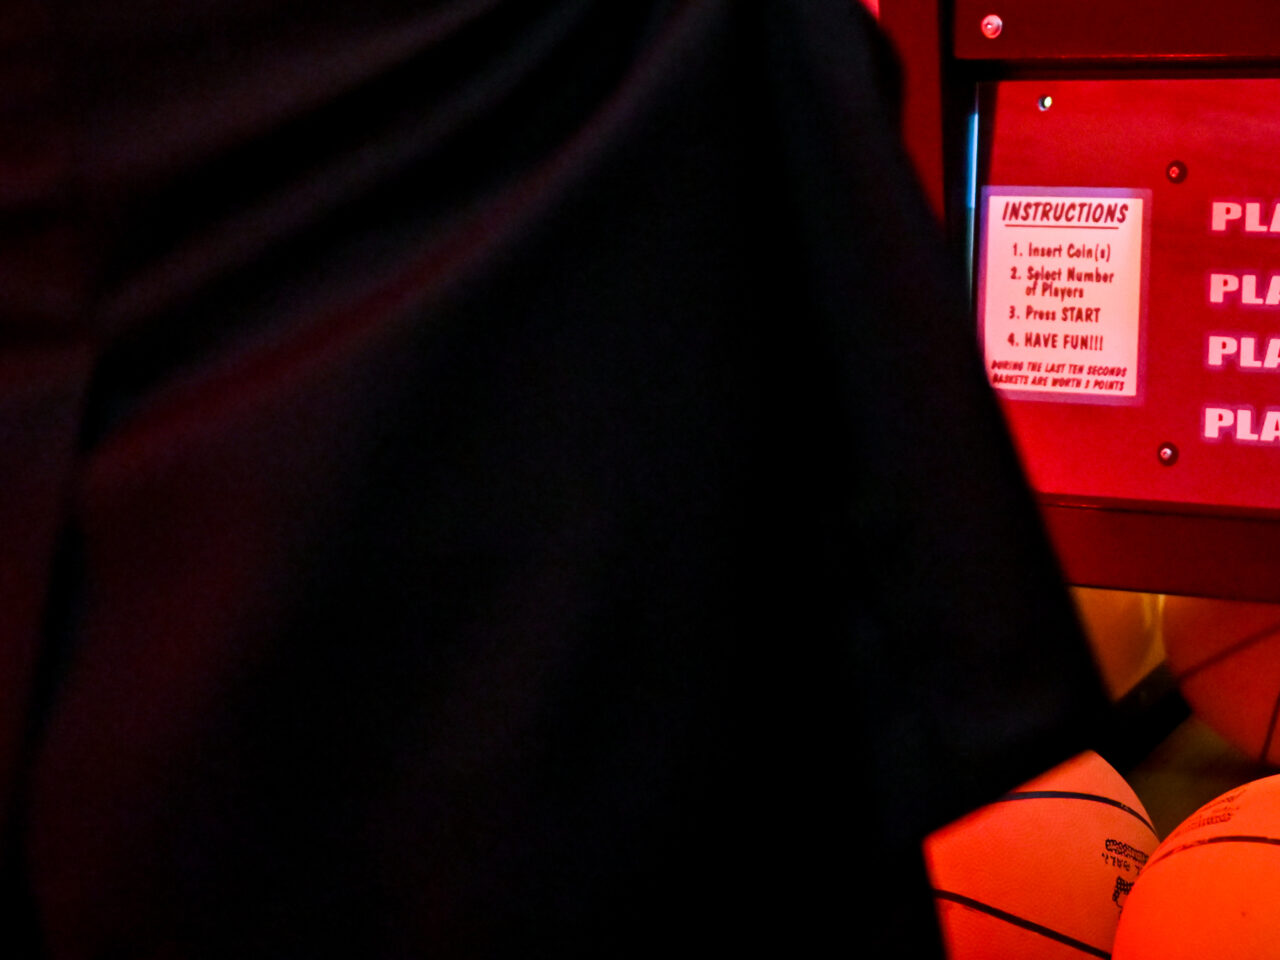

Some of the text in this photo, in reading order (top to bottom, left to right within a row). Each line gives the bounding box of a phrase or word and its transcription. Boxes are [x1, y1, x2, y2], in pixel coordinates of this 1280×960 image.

[1002, 201, 1129, 224] INSTRUCTIONS
[1013, 242, 1111, 263] 1. Insert Coin(s)
[1010, 265, 1115, 283] 2. Select Number
[1025, 281, 1084, 302] of Players
[1008, 305, 1101, 323] 3. Press START
[1007, 332, 1104, 352] 4. HAVE FUN!!!
[1027, 361, 1043, 373] THE
[1045, 363, 1066, 374] LAST
[1068, 364, 1084, 375] TEN
[1087, 365, 1128, 378] SECONDS
[992, 373, 1029, 385] BASKETS
[1031, 375, 1049, 387] ARE
[1051, 377, 1081, 389] WORTH
[1093, 380, 1125, 391] POINTS
